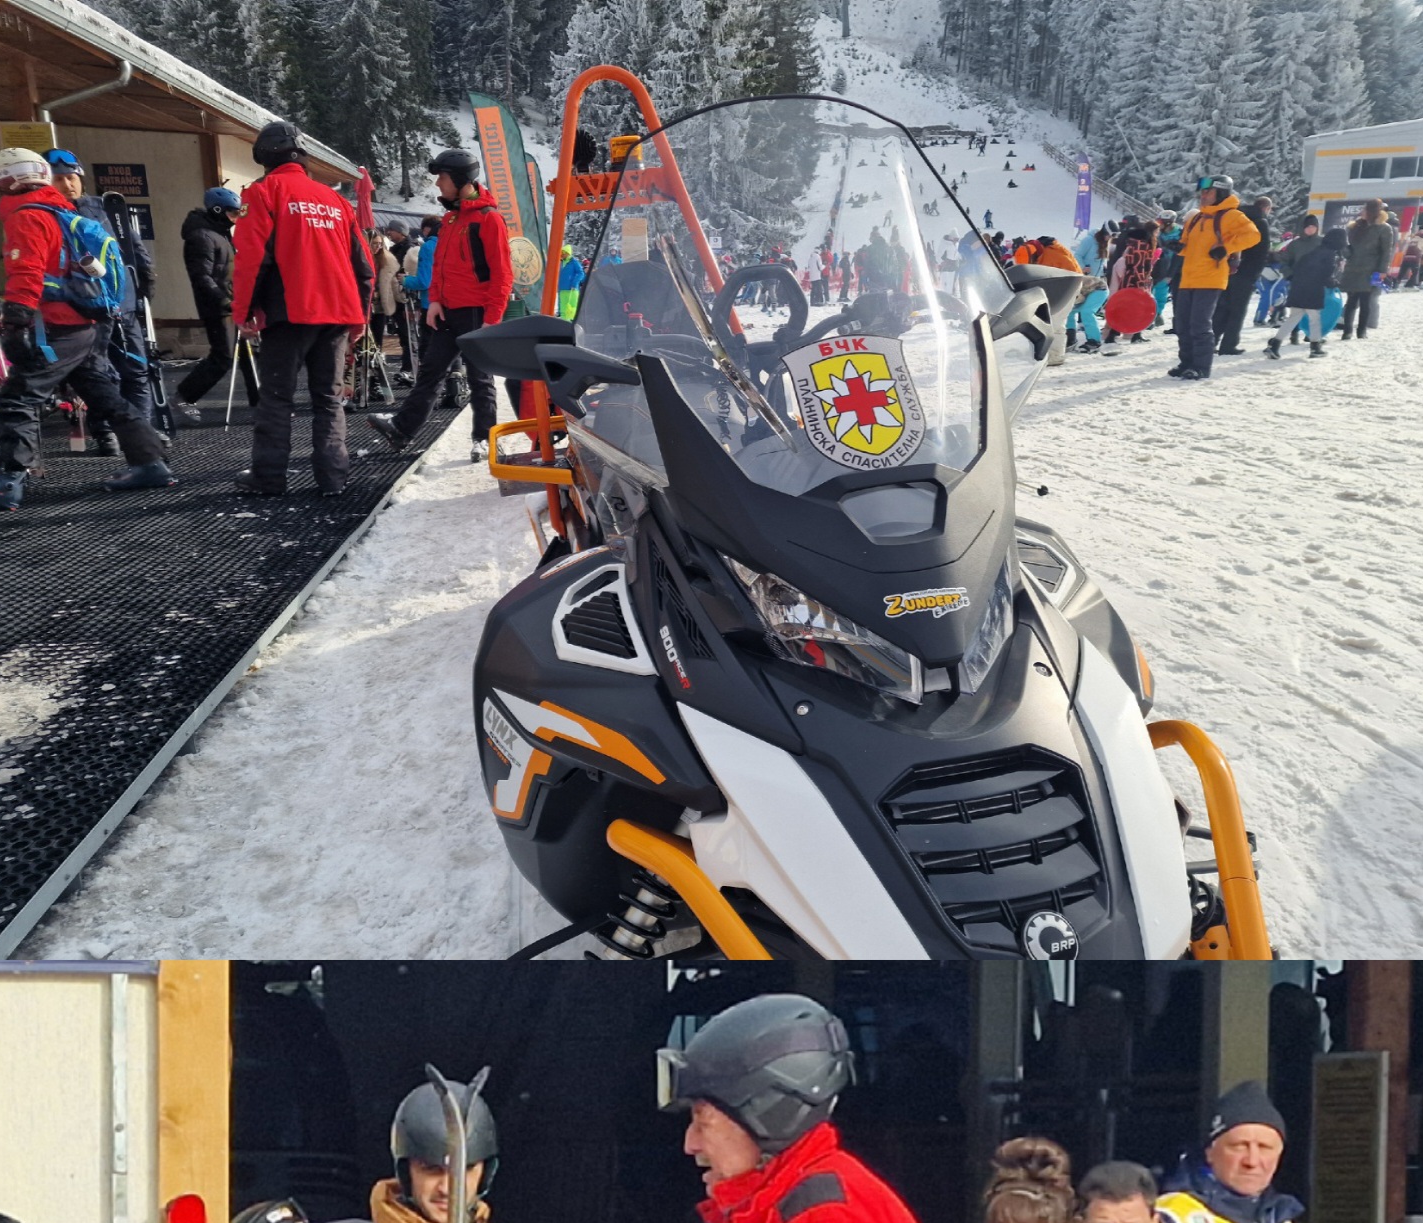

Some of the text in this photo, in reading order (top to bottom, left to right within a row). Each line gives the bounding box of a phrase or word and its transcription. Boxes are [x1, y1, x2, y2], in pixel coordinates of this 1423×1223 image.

[99, 175, 143, 186] ENTRANCE
[288, 202, 342, 221] RESCUE
[306, 218, 335, 230] TEAM
[818, 338, 868, 356] БЧК
[797, 365, 921, 469] ПЛАНИНСКА СПАСИТЕЛНА СЛУЖБА
[884, 594, 962, 616] ZUNDERT
[659, 625, 678, 662] 900
[485, 706, 518, 751] LYNX
[1051, 938, 1075, 953] BRP
